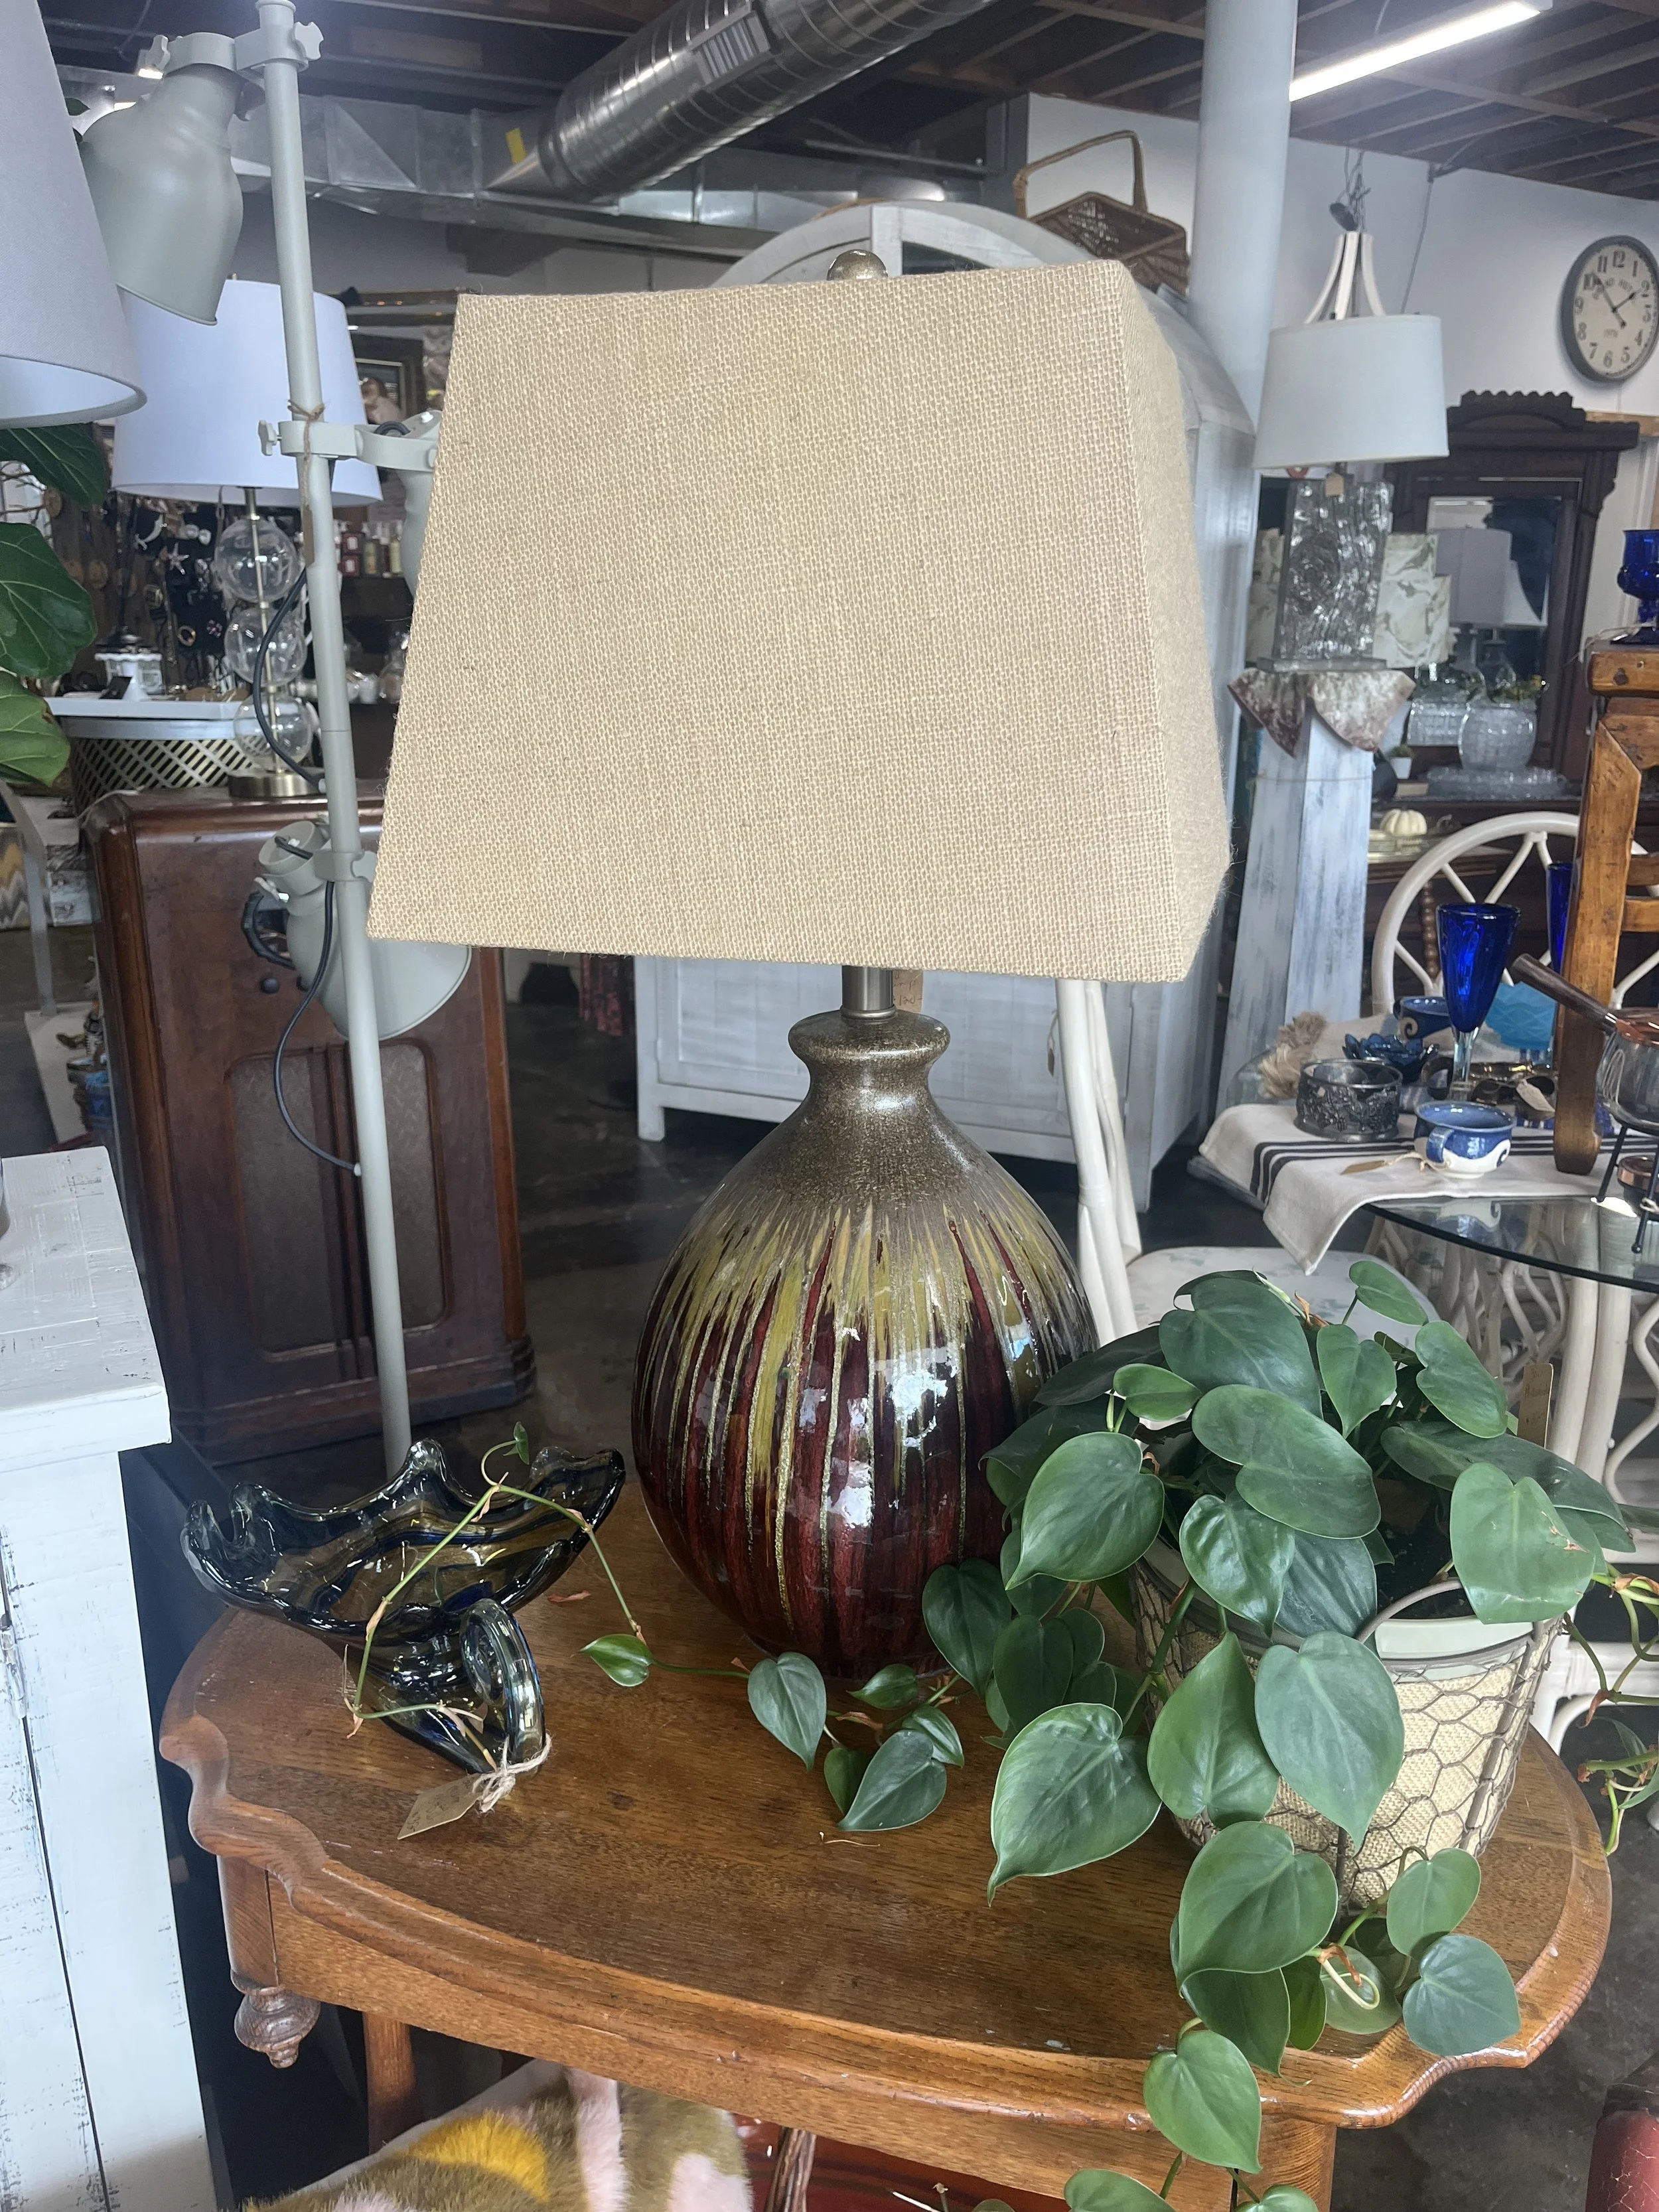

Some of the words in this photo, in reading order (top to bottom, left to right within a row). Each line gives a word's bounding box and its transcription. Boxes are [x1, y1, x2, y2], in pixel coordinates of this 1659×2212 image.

[1597, 255, 1608, 272] 11
[1612, 250, 1626, 268] 12
[1632, 260, 1638, 277] 1
[1641, 279, 1650, 297] 2
[1575, 296, 1584, 315] 9
[1642, 304, 1651, 323] 3
[1577, 322, 1587, 341] 8
[1634, 329, 1643, 346] 4
[1589, 342, 1598, 359] 7
[1603, 350, 1613, 368] 6
[1621, 346, 1630, 364] 5
